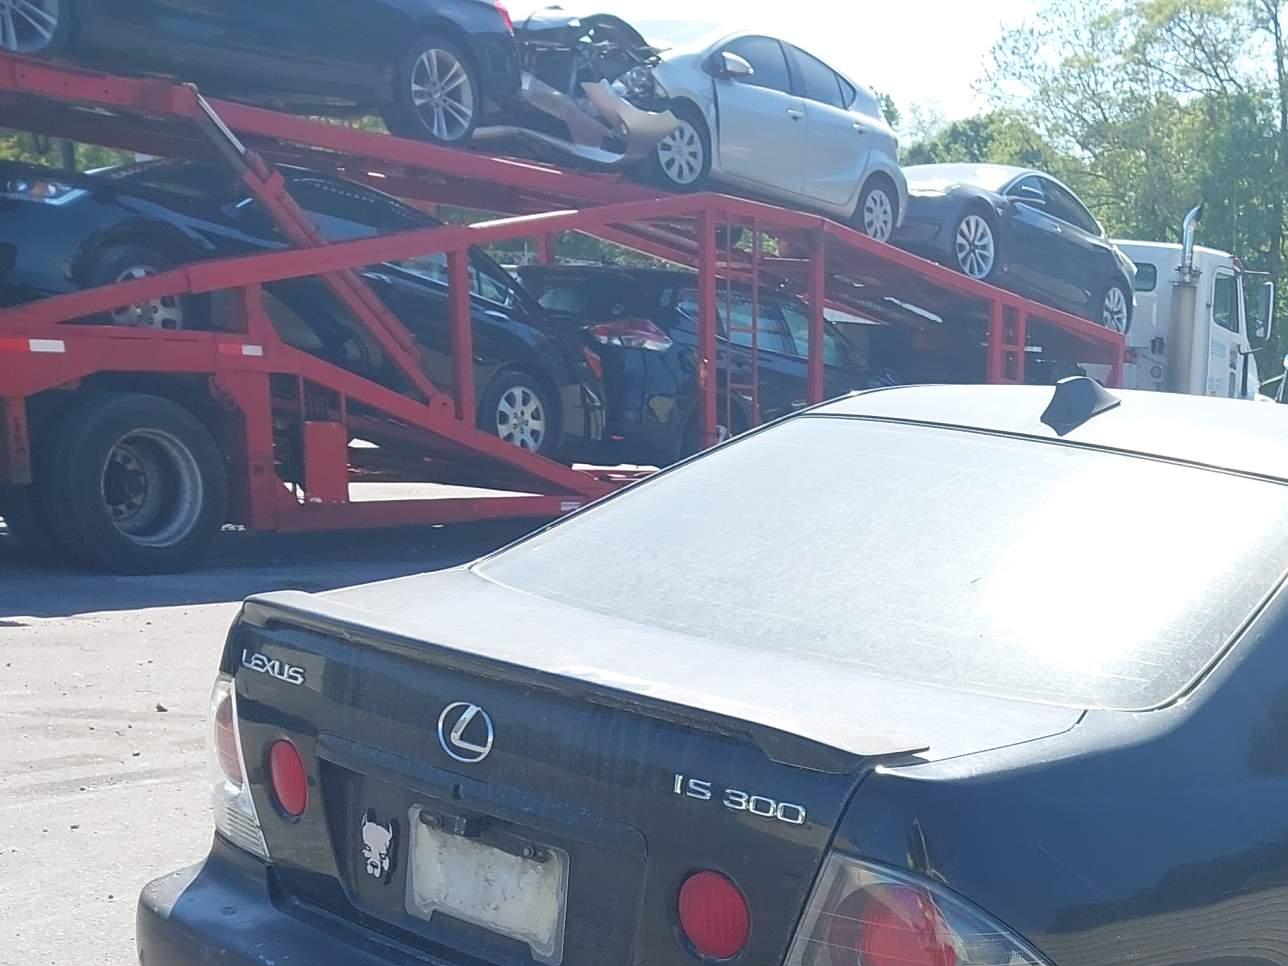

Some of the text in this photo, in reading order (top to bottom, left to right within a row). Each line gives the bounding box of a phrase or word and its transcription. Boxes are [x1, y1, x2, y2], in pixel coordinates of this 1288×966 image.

[241, 648, 305, 685] LEXUS
[673, 773, 806, 825] IS 300
